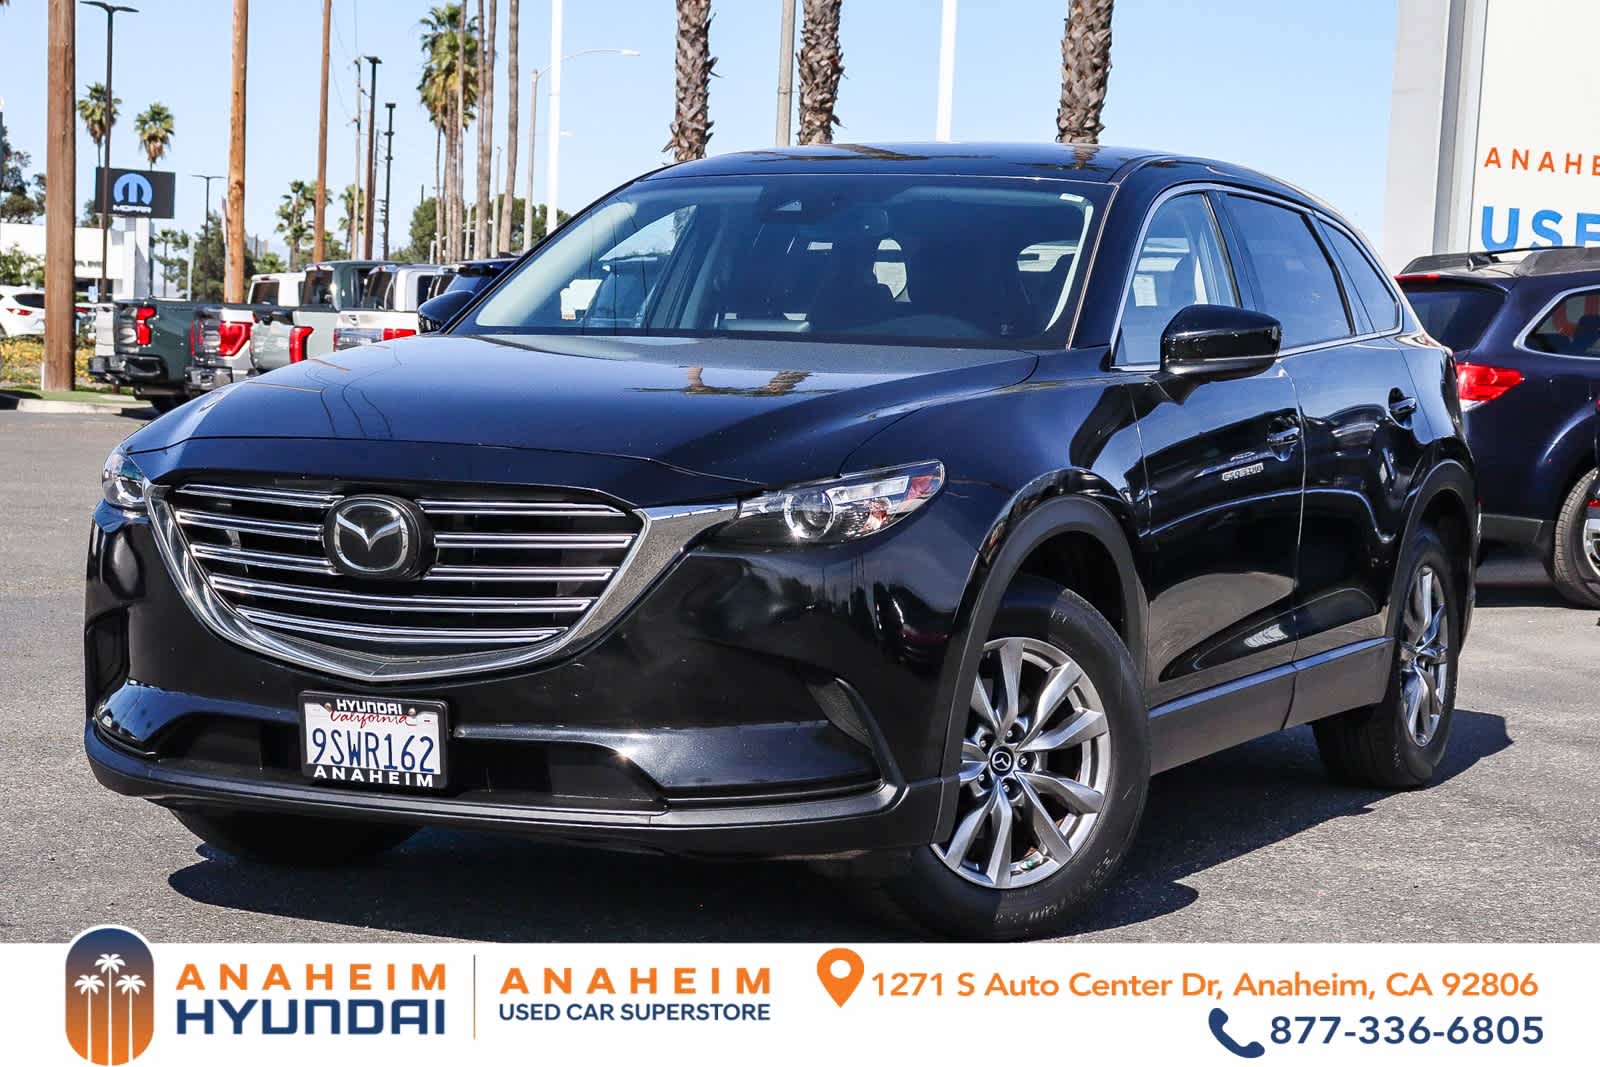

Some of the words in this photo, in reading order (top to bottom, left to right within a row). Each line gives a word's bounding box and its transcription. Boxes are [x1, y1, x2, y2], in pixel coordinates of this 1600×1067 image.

[336, 699, 403, 715] HYUNDAI
[330, 709, 417, 729] California
[312, 728, 434, 773] 9SWR162
[313, 765, 433, 788] ANAHEIM
